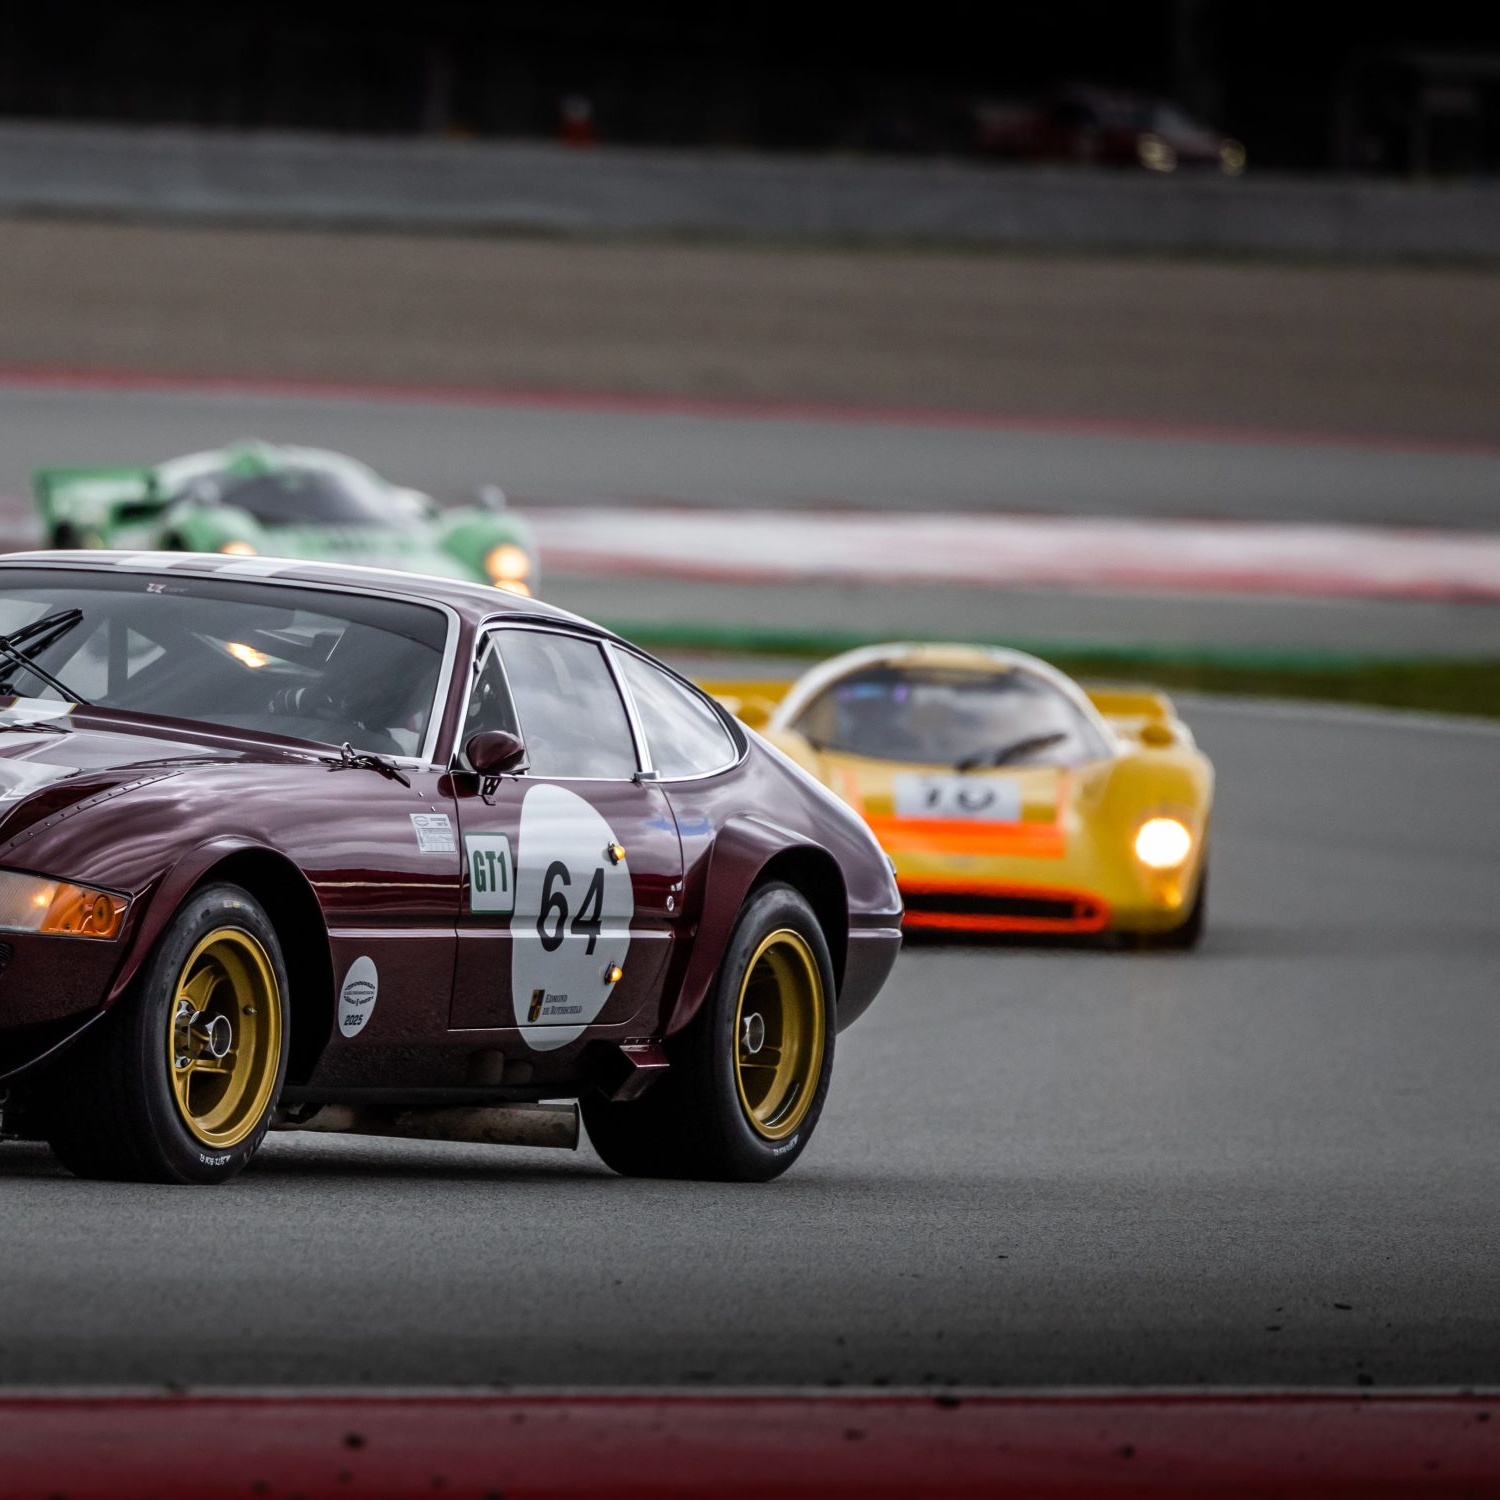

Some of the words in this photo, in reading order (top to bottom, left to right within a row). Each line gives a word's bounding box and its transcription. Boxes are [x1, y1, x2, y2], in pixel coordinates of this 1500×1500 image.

[472, 849, 508, 892] GT1
[536, 860, 605, 956] 64
[343, 1014, 364, 1026] 2025
